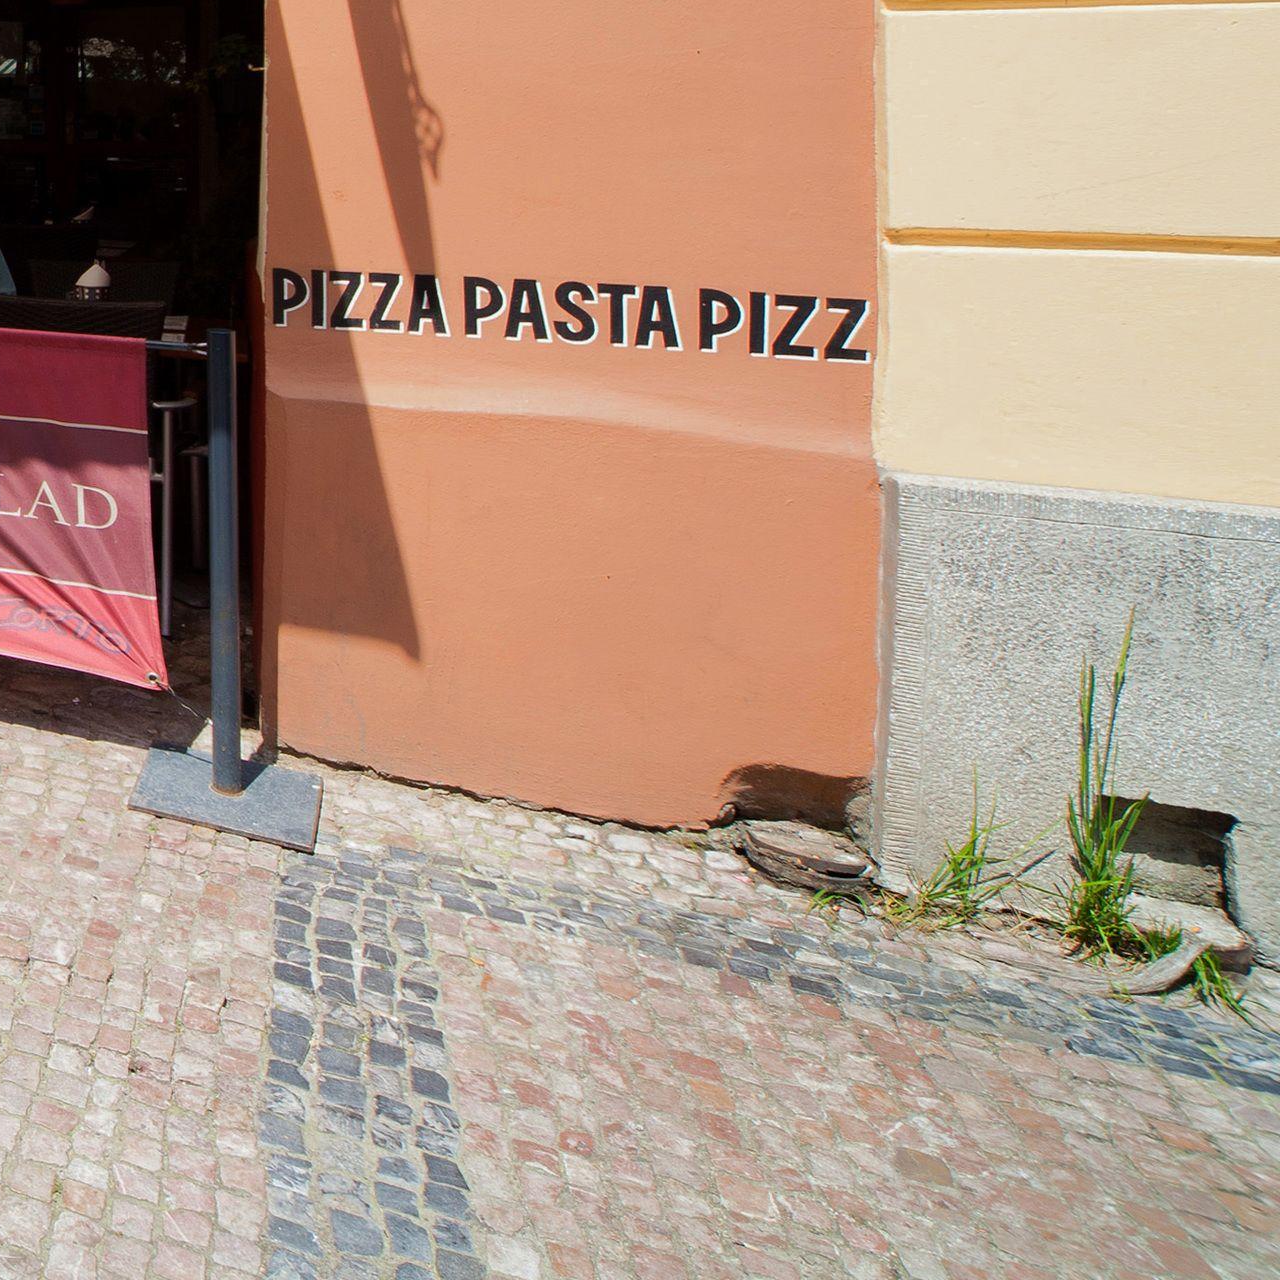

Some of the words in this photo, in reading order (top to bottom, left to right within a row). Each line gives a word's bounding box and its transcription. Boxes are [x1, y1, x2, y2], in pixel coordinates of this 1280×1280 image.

[271, 267, 452, 337] PIZZA
[463, 275, 683, 351] PASTA
[698, 288, 872, 365] PIZZ
